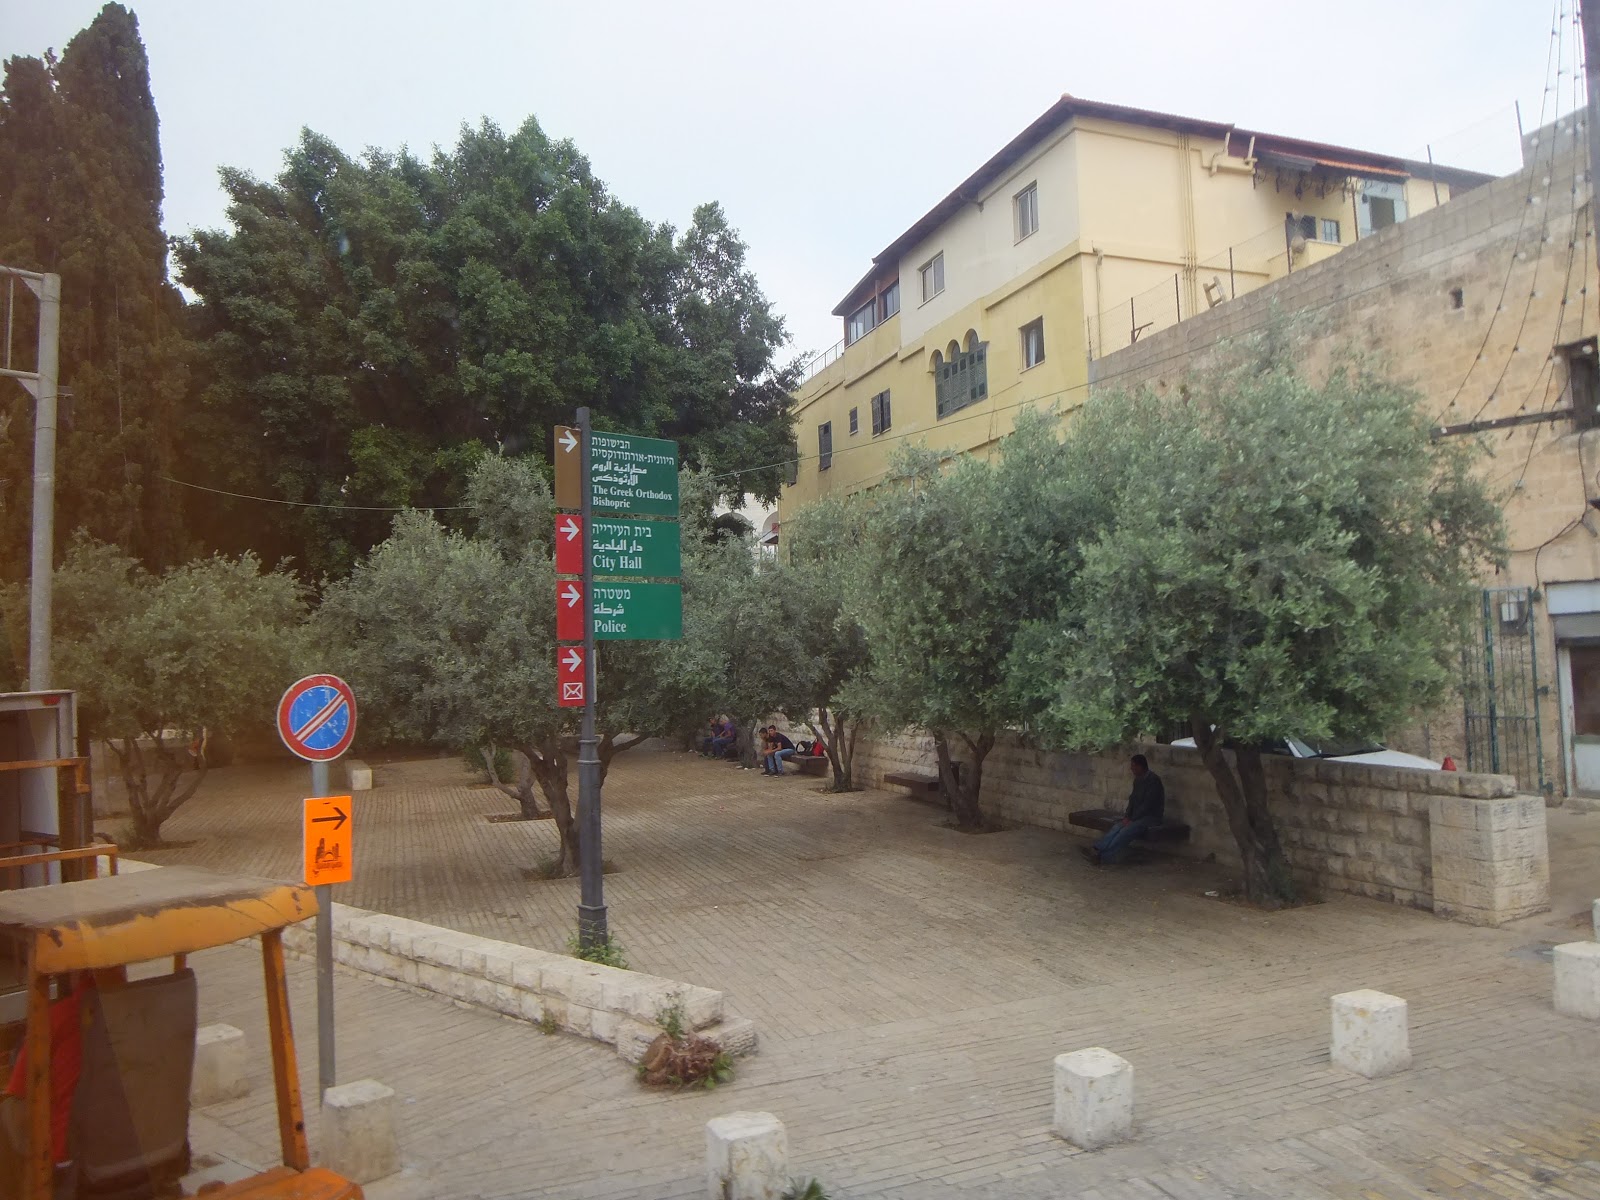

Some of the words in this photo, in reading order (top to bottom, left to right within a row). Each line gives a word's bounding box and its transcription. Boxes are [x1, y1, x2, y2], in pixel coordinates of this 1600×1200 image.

[591, 436, 630, 449] הבישופות
[592, 460, 612, 472] الروم
[614, 462, 647, 474] مطرانية
[592, 485, 608, 494] The
[610, 486, 634, 497] Greek
[636, 488, 672, 500] Orthodox
[593, 496, 630, 509] Bishopric
[592, 524, 630, 536] העירייה
[634, 526, 652, 538] בית
[592, 538, 627, 553] البلدية
[629, 540, 644, 553] دار
[592, 554, 616, 572] City
[620, 556, 642, 569] Hall
[594, 588, 630, 600] משטרה
[594, 602, 624, 616] شرطة
[594, 620, 626, 632] Police
